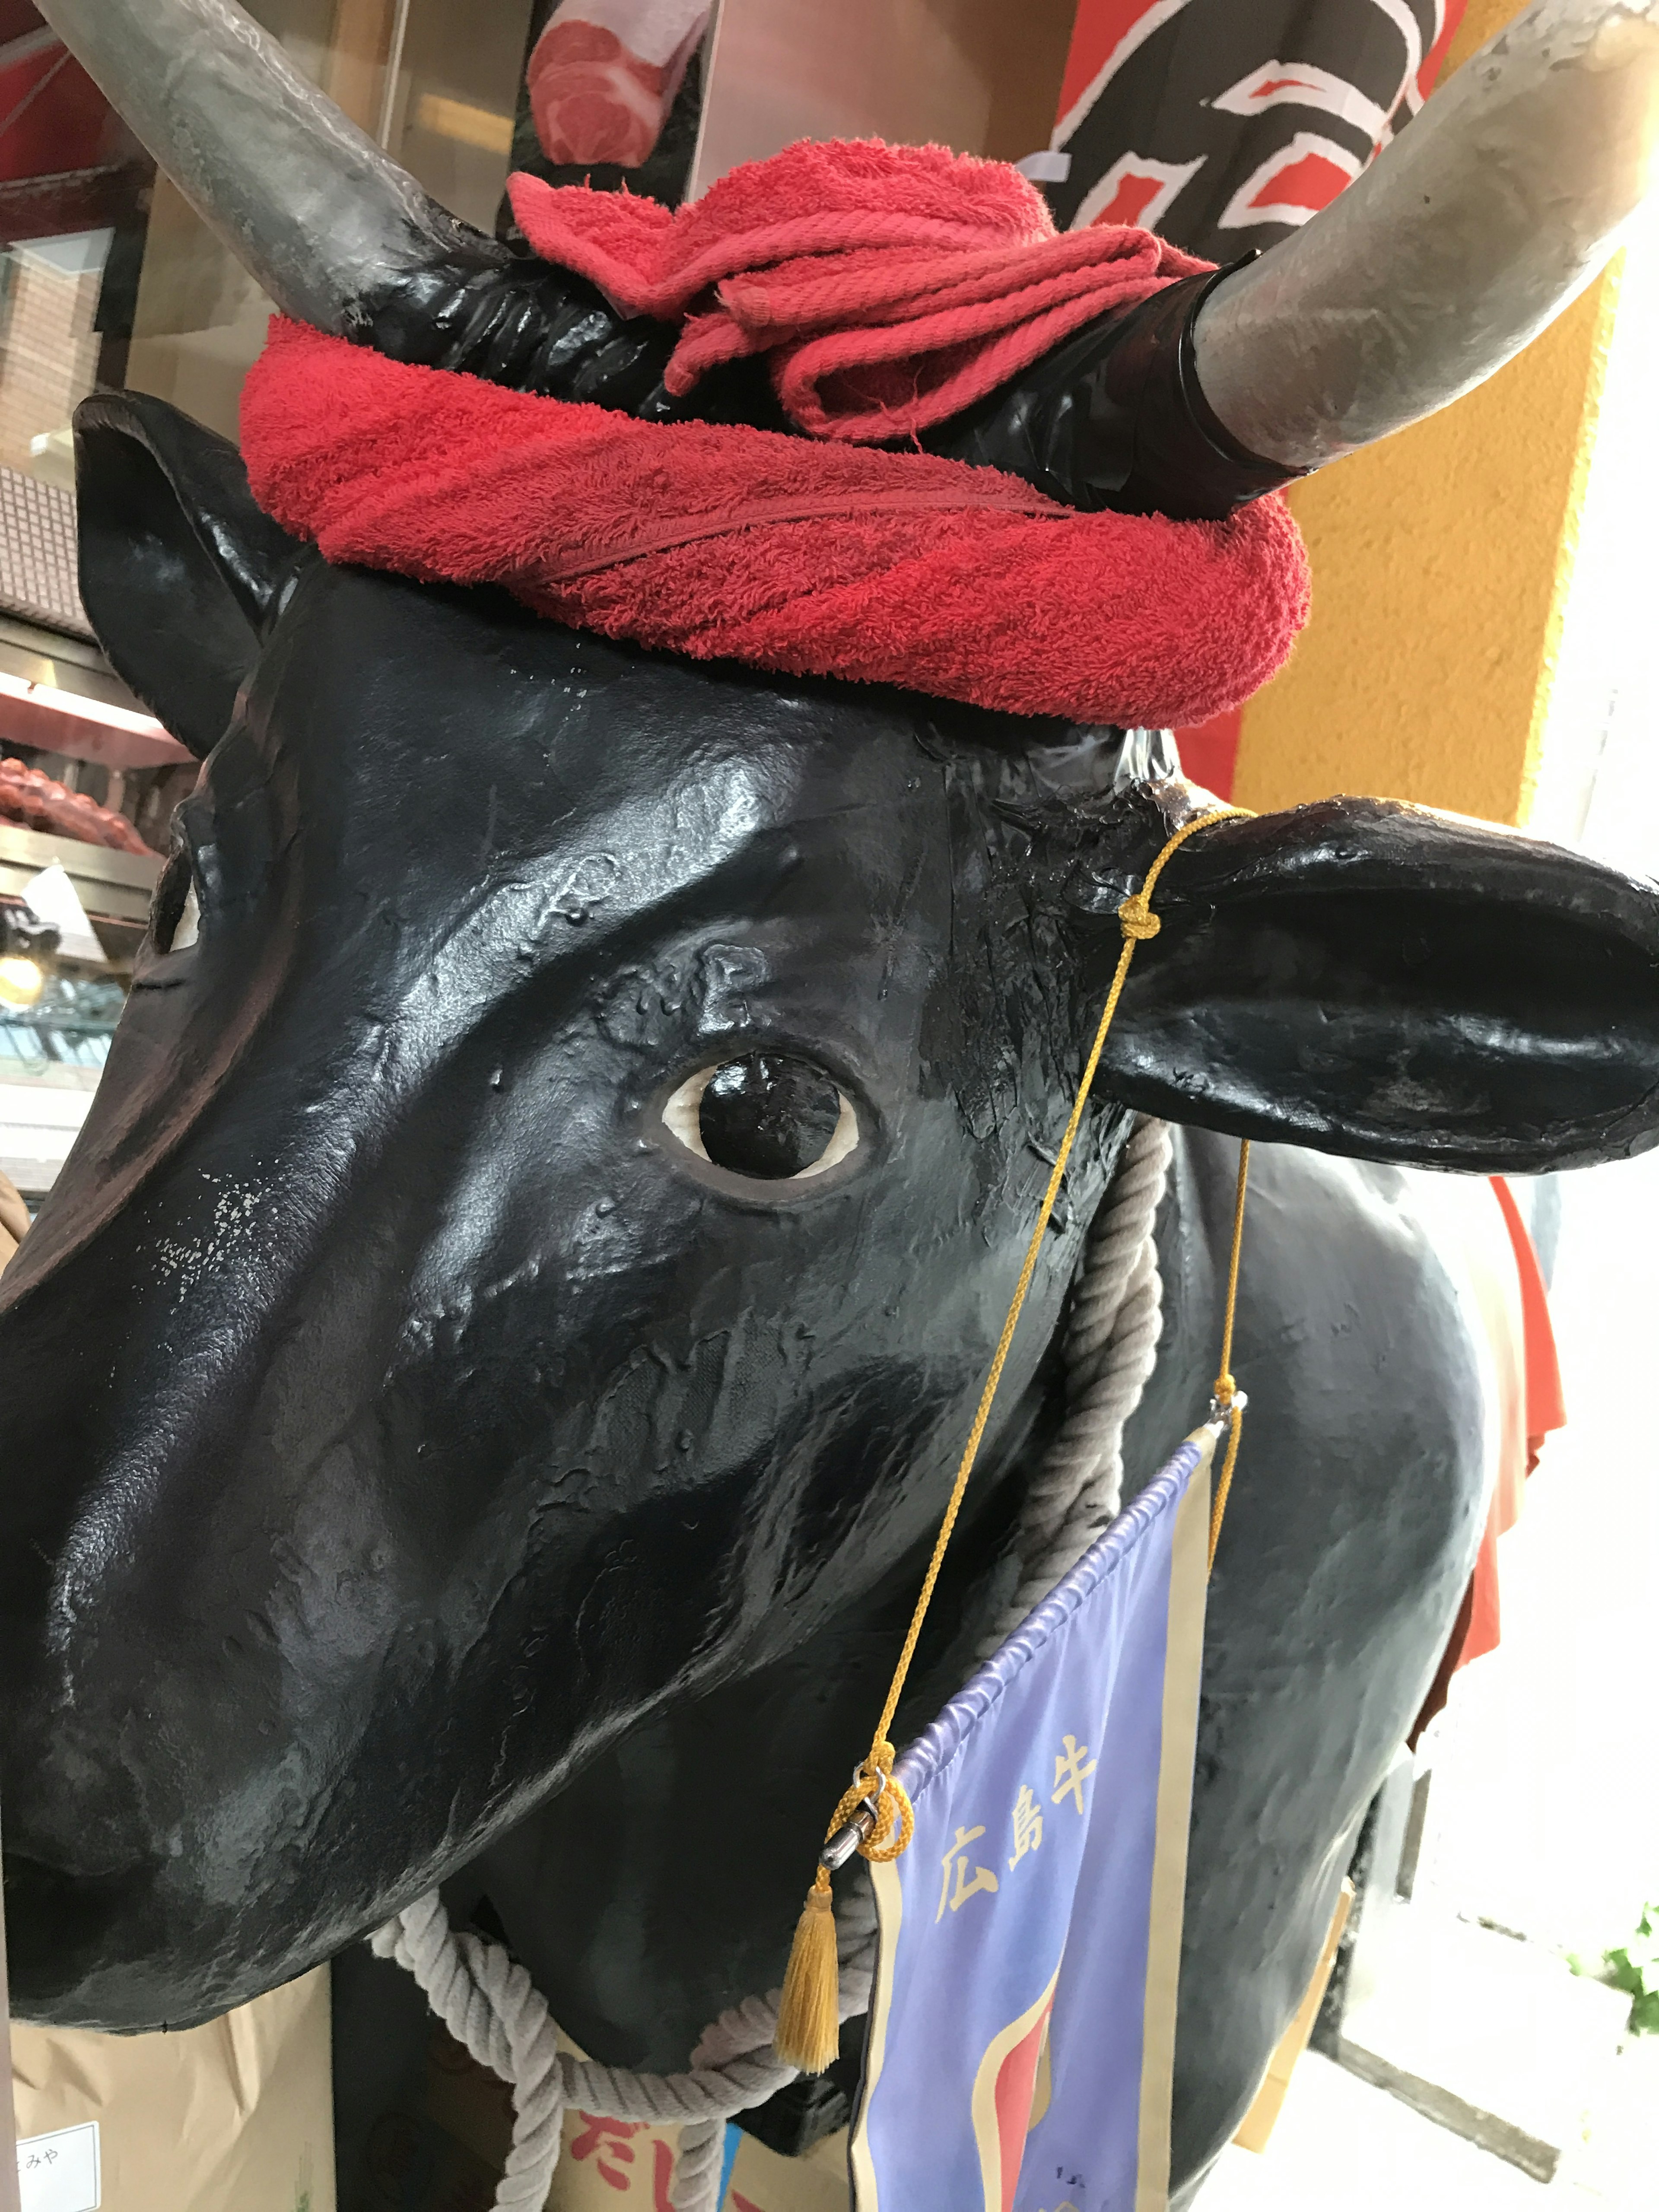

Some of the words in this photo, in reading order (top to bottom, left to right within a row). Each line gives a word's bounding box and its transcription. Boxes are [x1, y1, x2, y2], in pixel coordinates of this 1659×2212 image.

[935, 1734, 1098, 1924] 広島牛
[17, 2148, 58, 2174] みや
